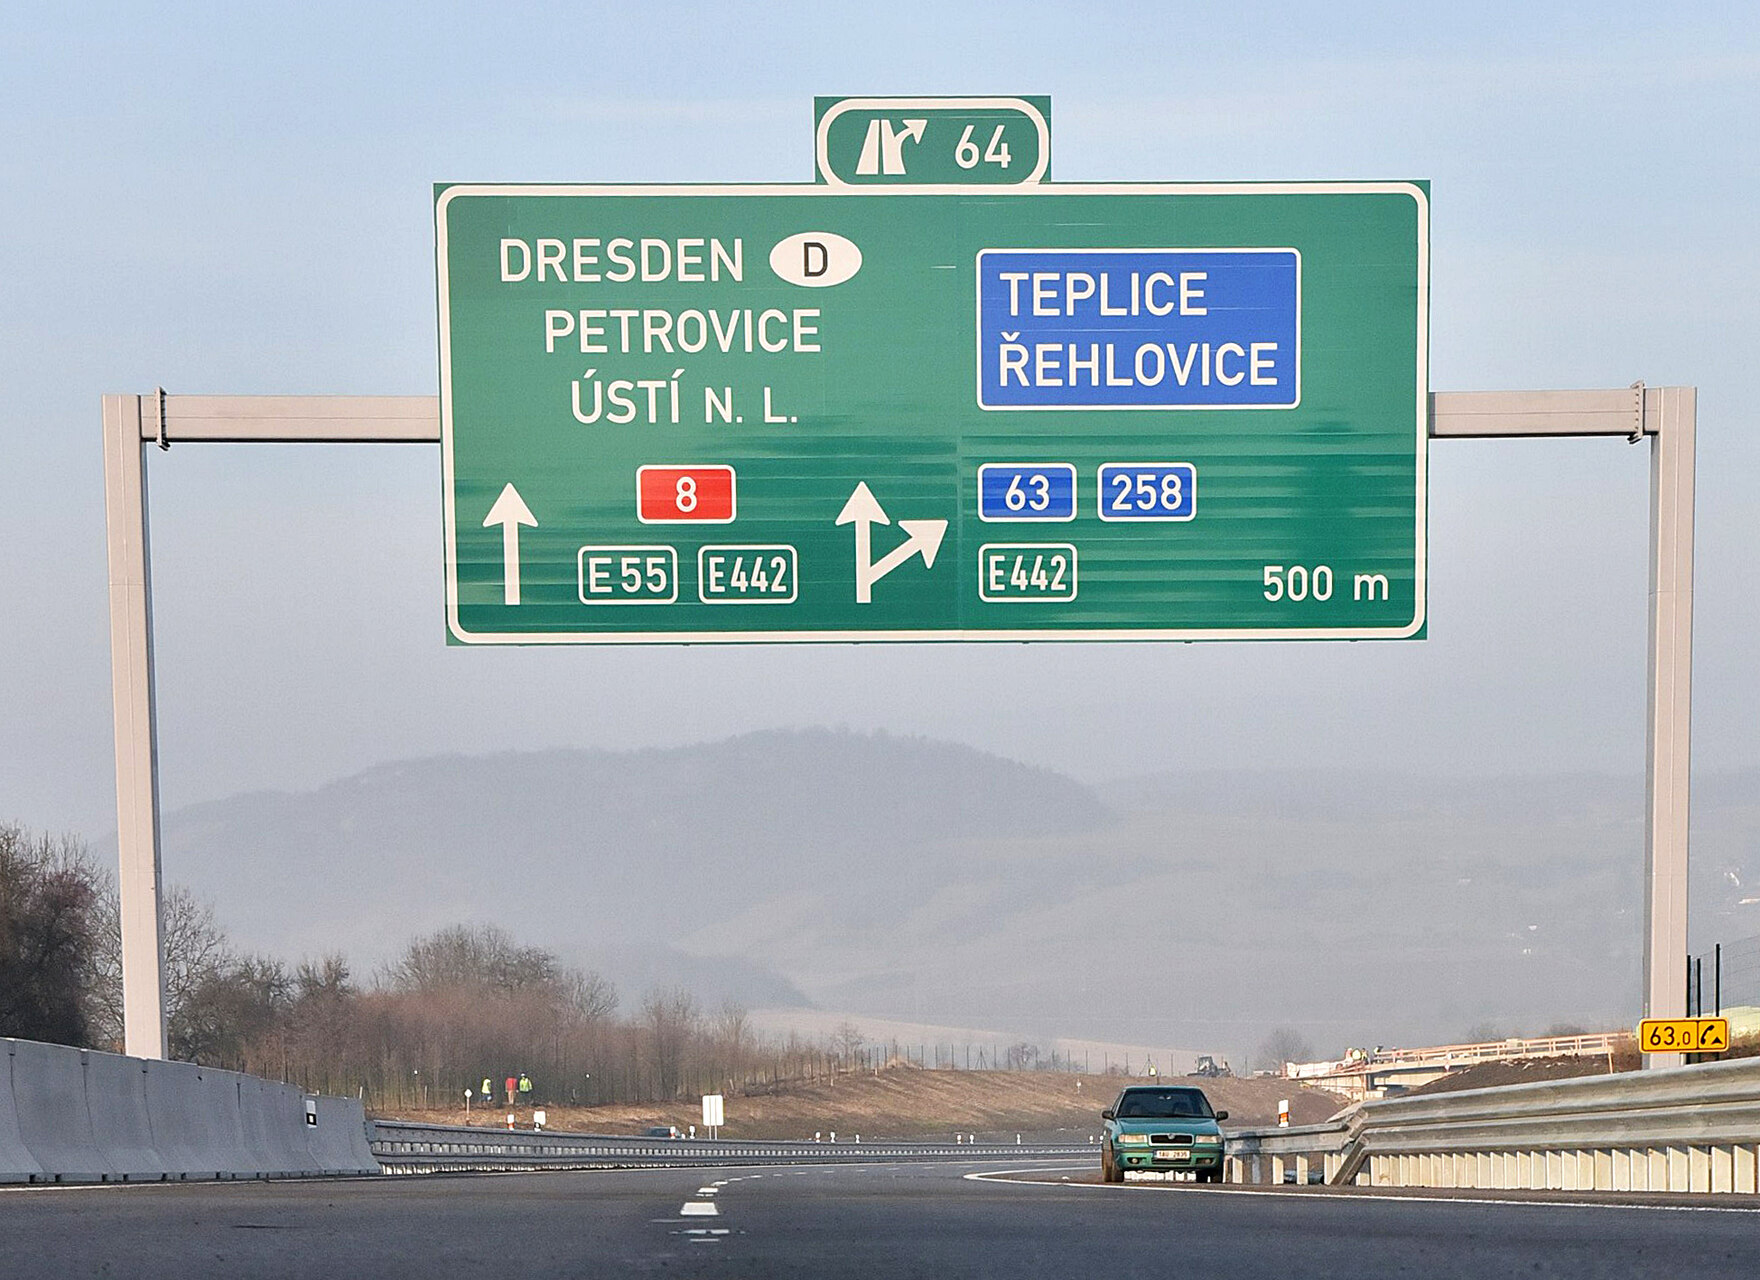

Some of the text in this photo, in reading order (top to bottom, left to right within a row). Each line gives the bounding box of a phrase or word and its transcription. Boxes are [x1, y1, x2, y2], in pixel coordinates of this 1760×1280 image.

[955, 125, 1011, 168] 64
[501, 238, 828, 282] DRESDEN D
[1000, 273, 1207, 316] TEPLICE
[546, 309, 820, 352] PETROVICE
[1000, 332, 1277, 386] ŘEHLOVICE
[572, 369, 797, 423] ÚSTÍ N. L.
[676, 477, 697, 512] 8
[1006, 475, 1049, 510] 63
[1112, 474, 1182, 510] 258
[710, 557, 786, 592] E442
[990, 555, 1066, 590] E442
[1264, 566, 1388, 601] 500 m
